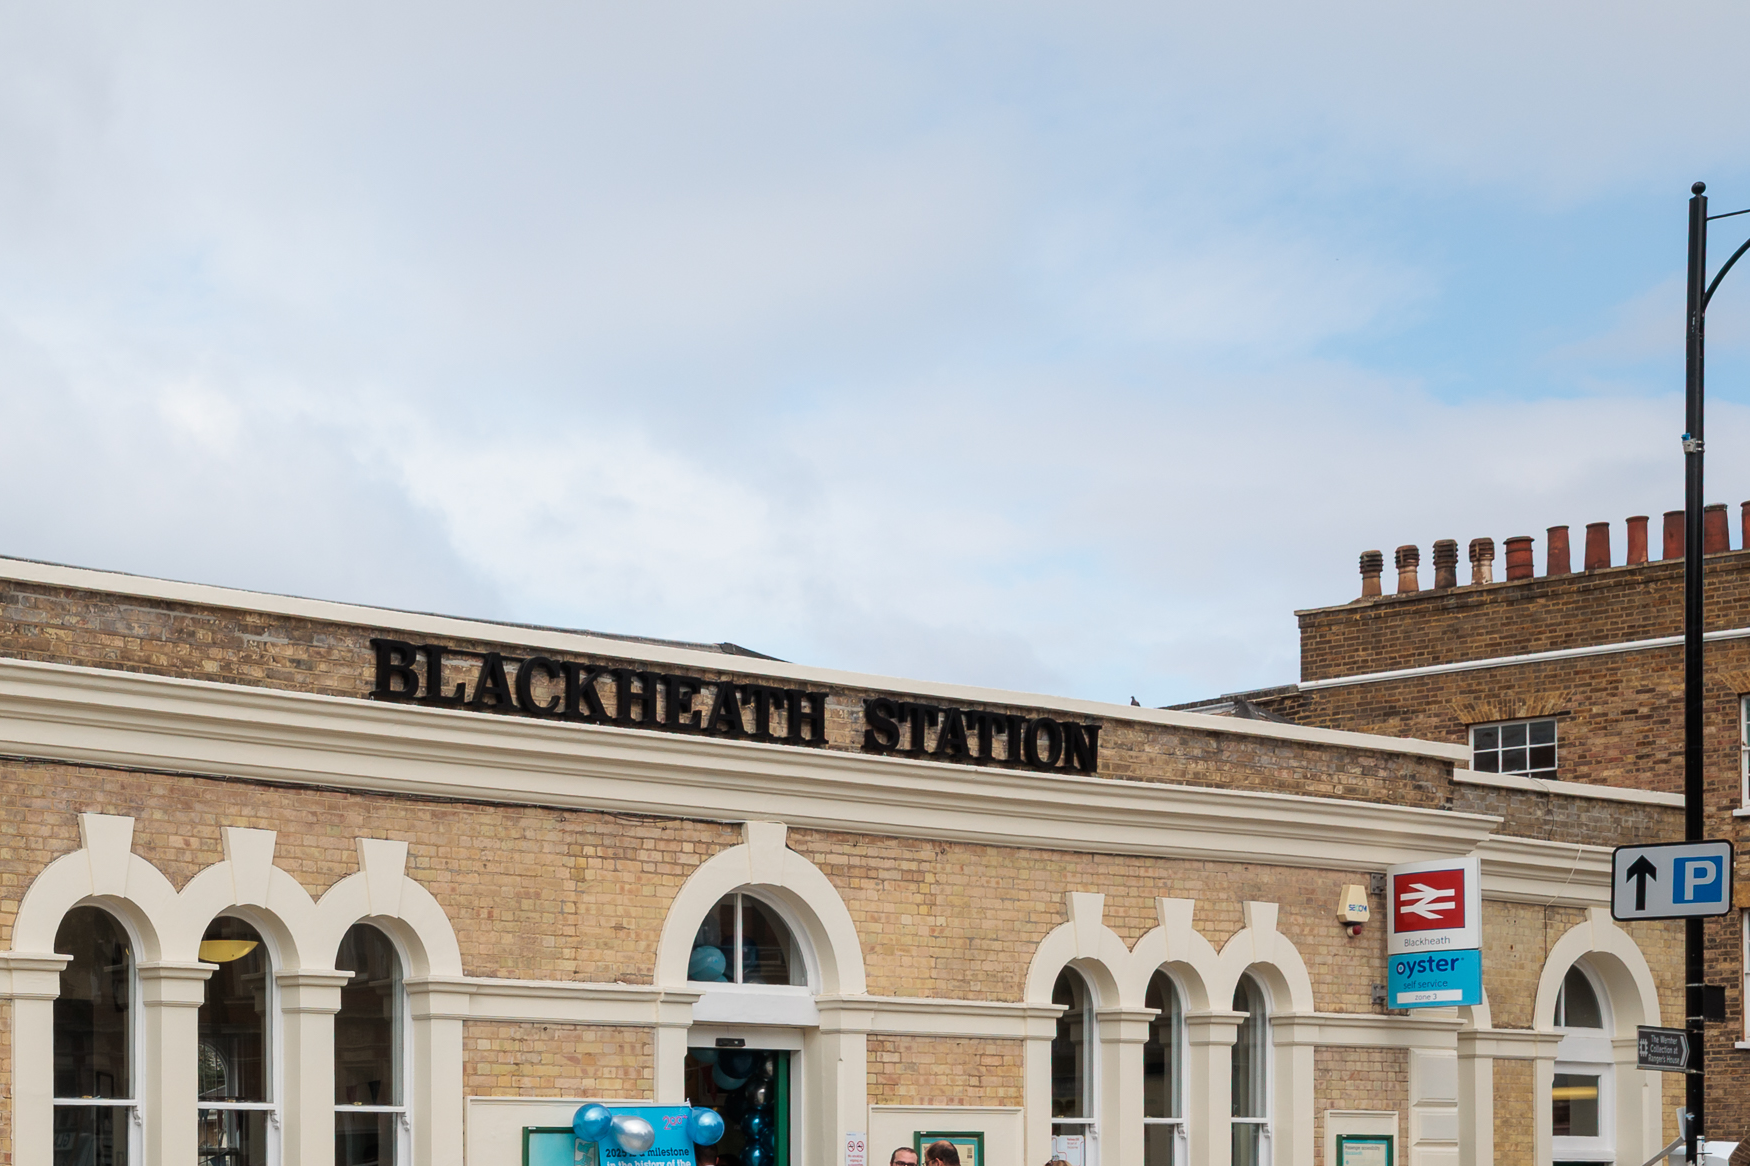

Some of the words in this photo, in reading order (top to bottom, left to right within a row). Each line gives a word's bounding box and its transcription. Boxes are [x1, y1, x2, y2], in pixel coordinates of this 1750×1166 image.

[369, 638, 829, 744] BLACKHEATH
[863, 697, 1102, 773] STATION
[1684, 861, 1716, 900] P
[1348, 904, 1367, 912] SECOM
[1404, 936, 1450, 947] Blackheath
[1397, 956, 1459, 979] oyster
[1404, 981, 1416, 990] self
[1418, 980, 1448, 988] service
[1651, 1035, 1659, 1043] The
[606, 1149, 626, 1157] 2025
[648, 1148, 689, 1157] milestone
